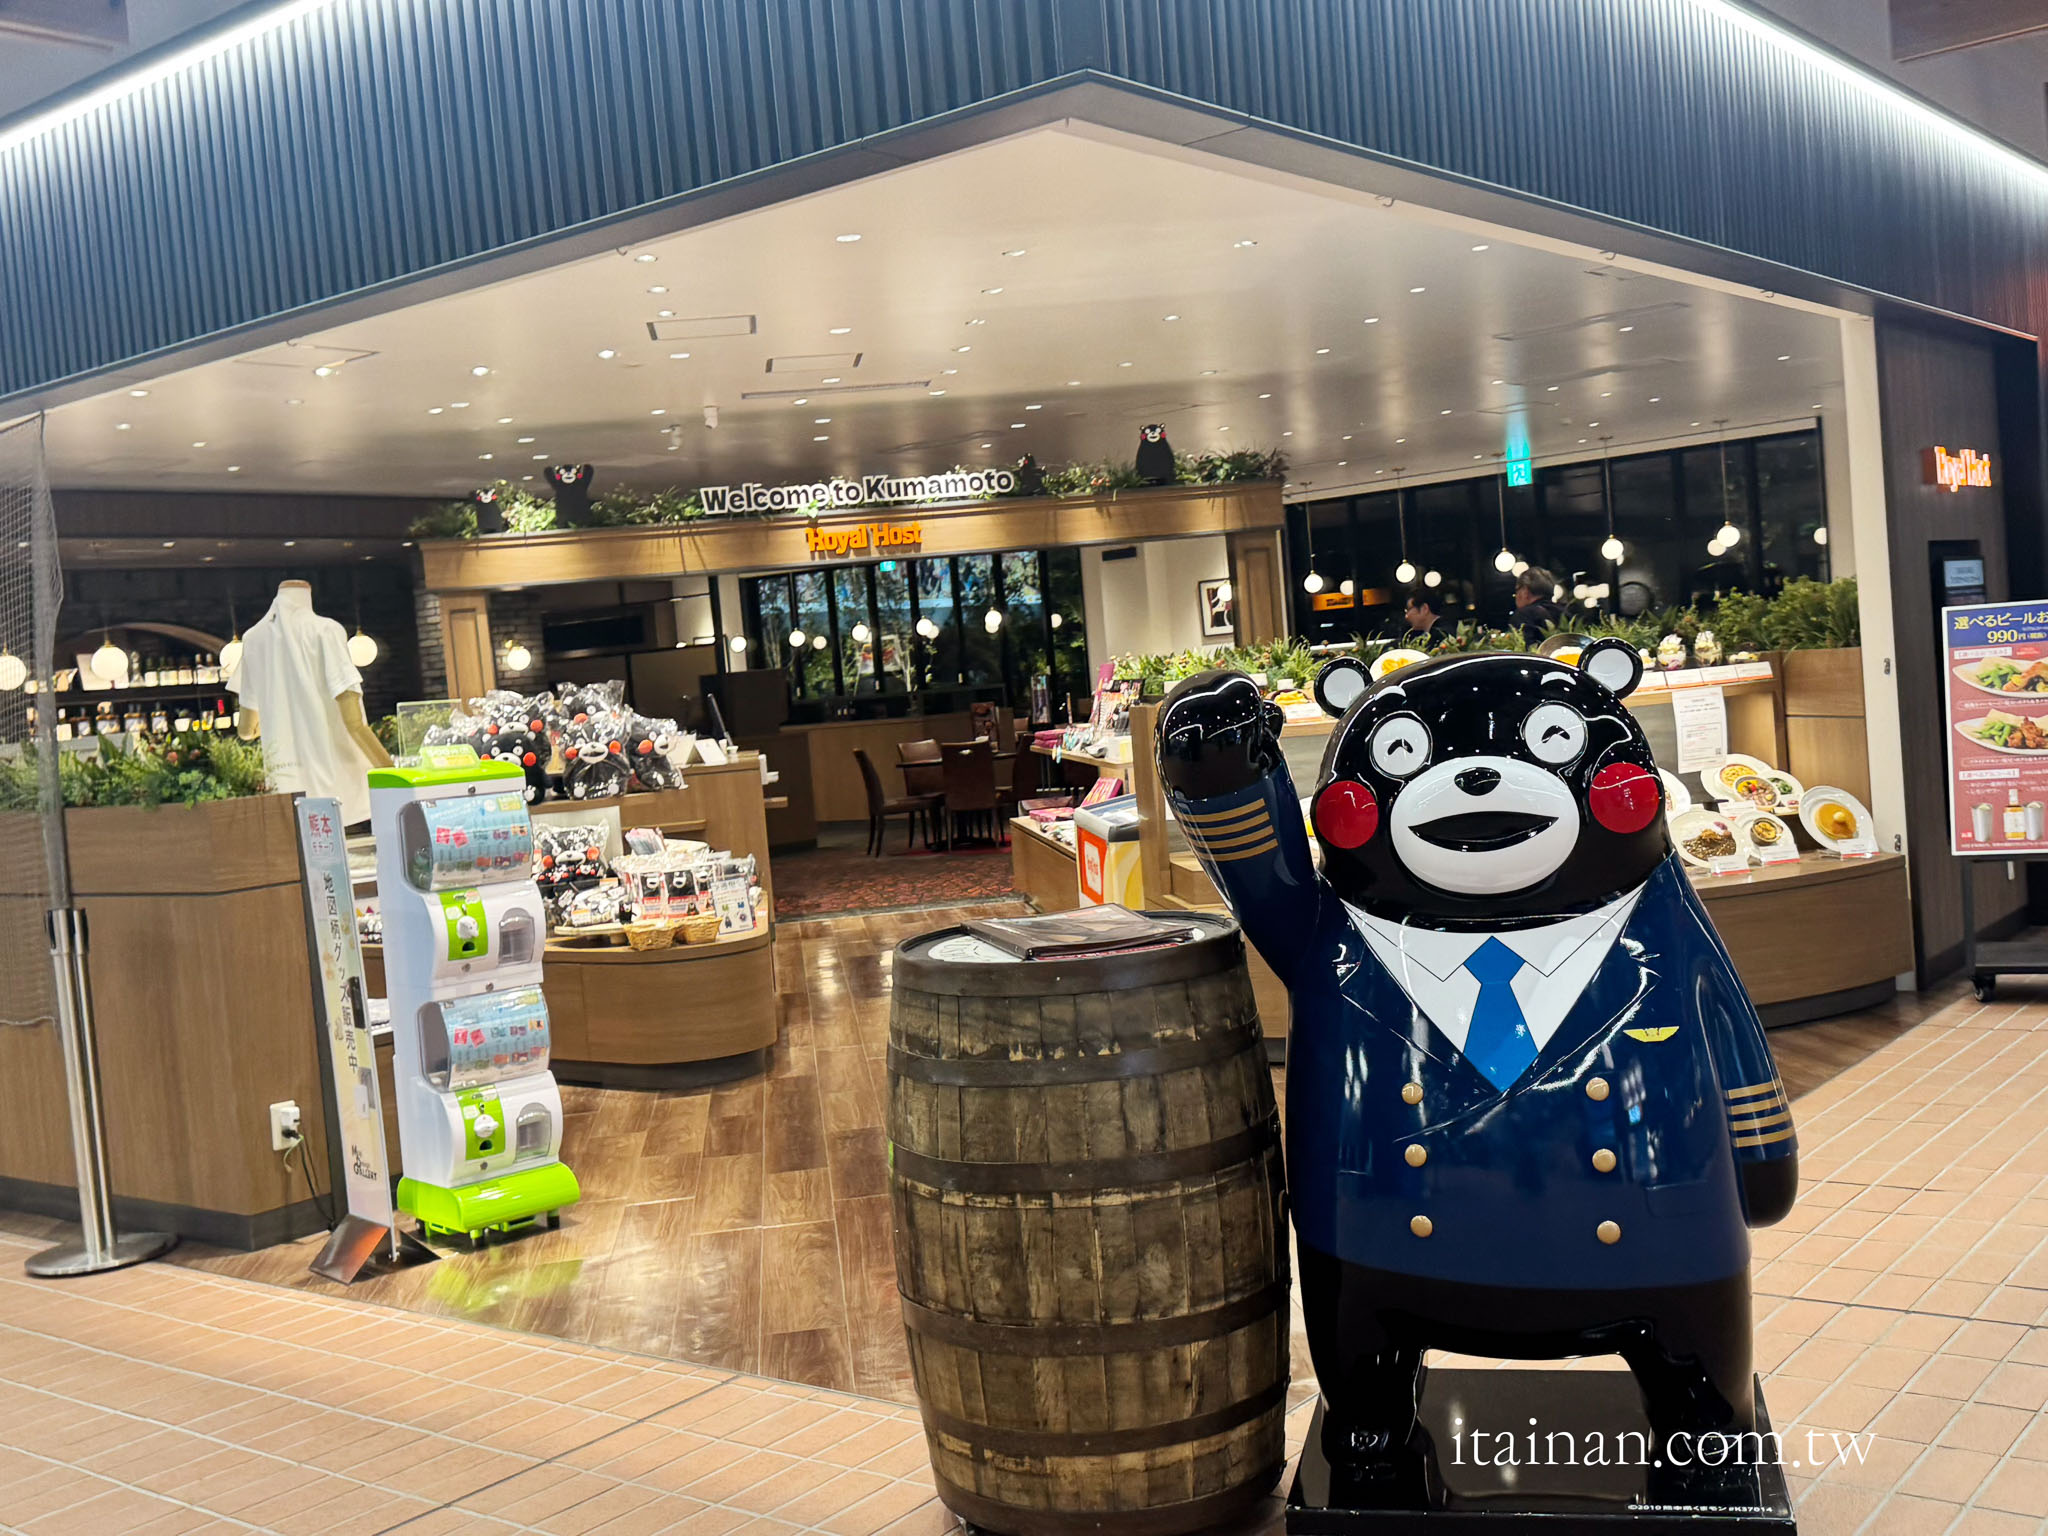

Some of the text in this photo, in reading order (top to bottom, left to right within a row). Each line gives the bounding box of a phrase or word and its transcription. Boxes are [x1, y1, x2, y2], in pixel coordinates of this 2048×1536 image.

[703, 471, 1012, 513] Welcome to Kumamoto
[806, 521, 923, 555] Royal Host
[308, 813, 332, 838] 熊本
